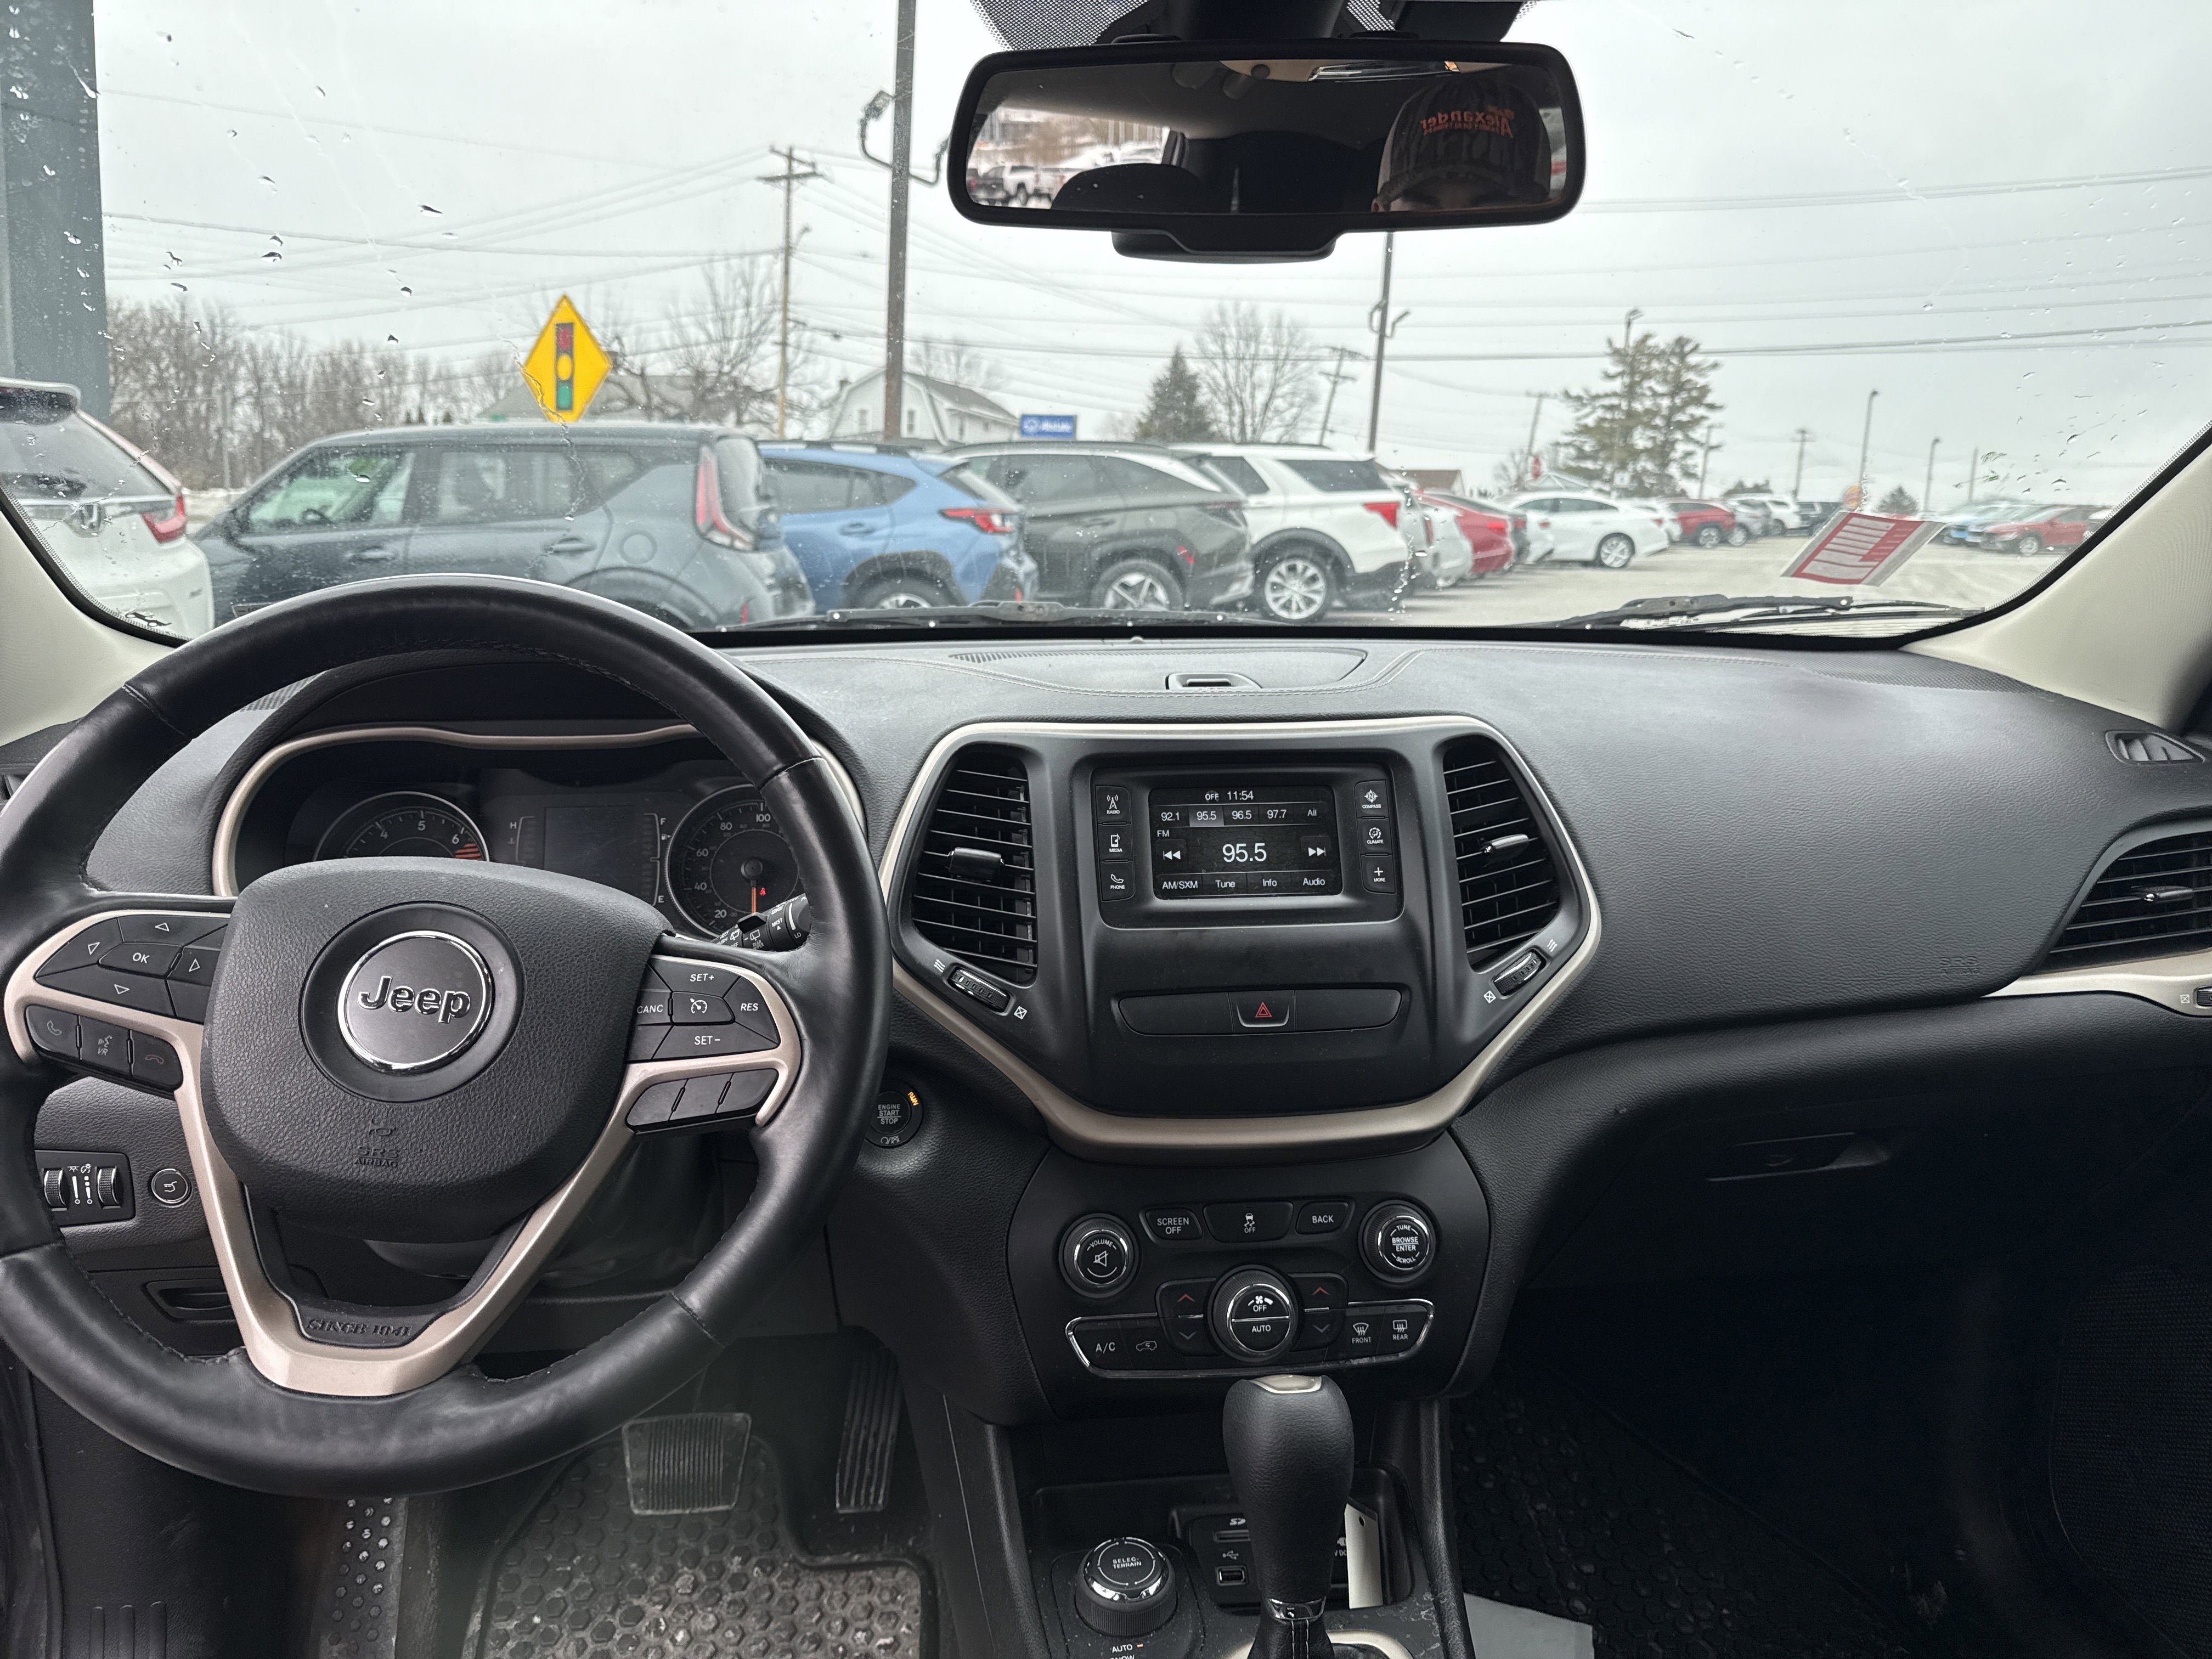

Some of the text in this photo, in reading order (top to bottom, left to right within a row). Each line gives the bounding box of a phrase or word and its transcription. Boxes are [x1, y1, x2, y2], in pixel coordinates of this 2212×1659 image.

[1227, 790, 1254, 800] 11:54
[756, 814, 771, 823] 100
[1161, 811, 1180, 821] 92.1
[1196, 811, 1217, 821] 95.5
[1232, 810, 1252, 820] 96.5
[1267, 809, 1287, 819] 97.7
[417, 821, 426, 831] 5
[720, 822, 733, 831] 80
[452, 833, 460, 845] 6
[696, 848, 709, 857] 60
[1222, 843, 1267, 862] 95.5
[694, 882, 708, 891] 40
[1162, 877, 1325, 889] AM/SXM Tune Info Audio
[658, 895, 664, 903] E
[714, 909, 727, 918] 20
[771, 917, 783, 928] MIST
[132, 952, 150, 964] OK
[690, 973, 715, 982] SET+
[358, 975, 471, 1024] Jeep
[636, 1004, 664, 1014] CANC
[740, 1002, 759, 1012] RES
[98, 1047, 109, 1056] VR
[907, 1091, 919, 1106] RUN
[1156, 1217, 1190, 1226] SCREEN
[1312, 1215, 1334, 1224] BACK
[1165, 1226, 1182, 1234] OFF
[1089, 1239, 1114, 1249] VOLUME
[1391, 1235, 1419, 1244] BROWSE
[1396, 1244, 1417, 1252] ENTER
[1396, 1256, 1417, 1265] SCROLL
[1251, 1324, 1272, 1333] AUTO
[1095, 1342, 1116, 1355] A/C
[1111, 1644, 1133, 1654] AUTO
